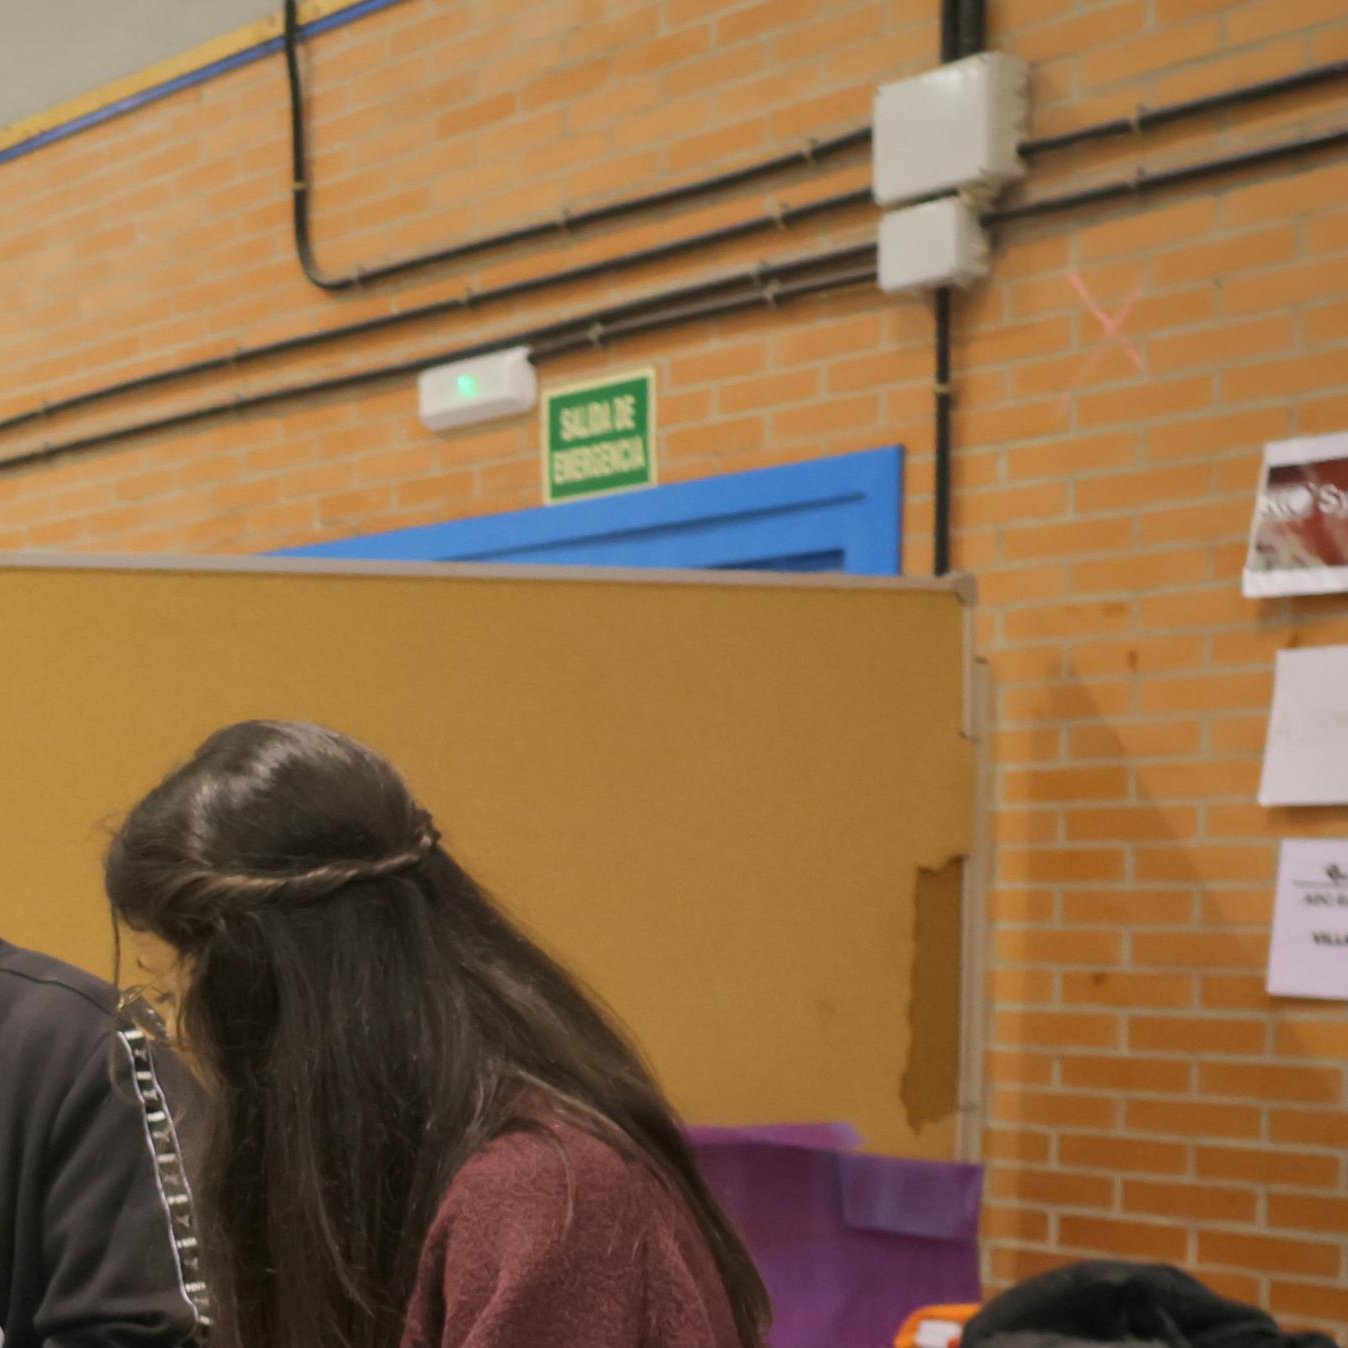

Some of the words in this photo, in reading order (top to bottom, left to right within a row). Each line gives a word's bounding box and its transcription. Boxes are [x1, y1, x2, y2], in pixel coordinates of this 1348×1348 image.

[559, 400, 612, 442] SALIDA
[613, 394, 636, 432] DE
[553, 435, 646, 485] EMERGENCIA
